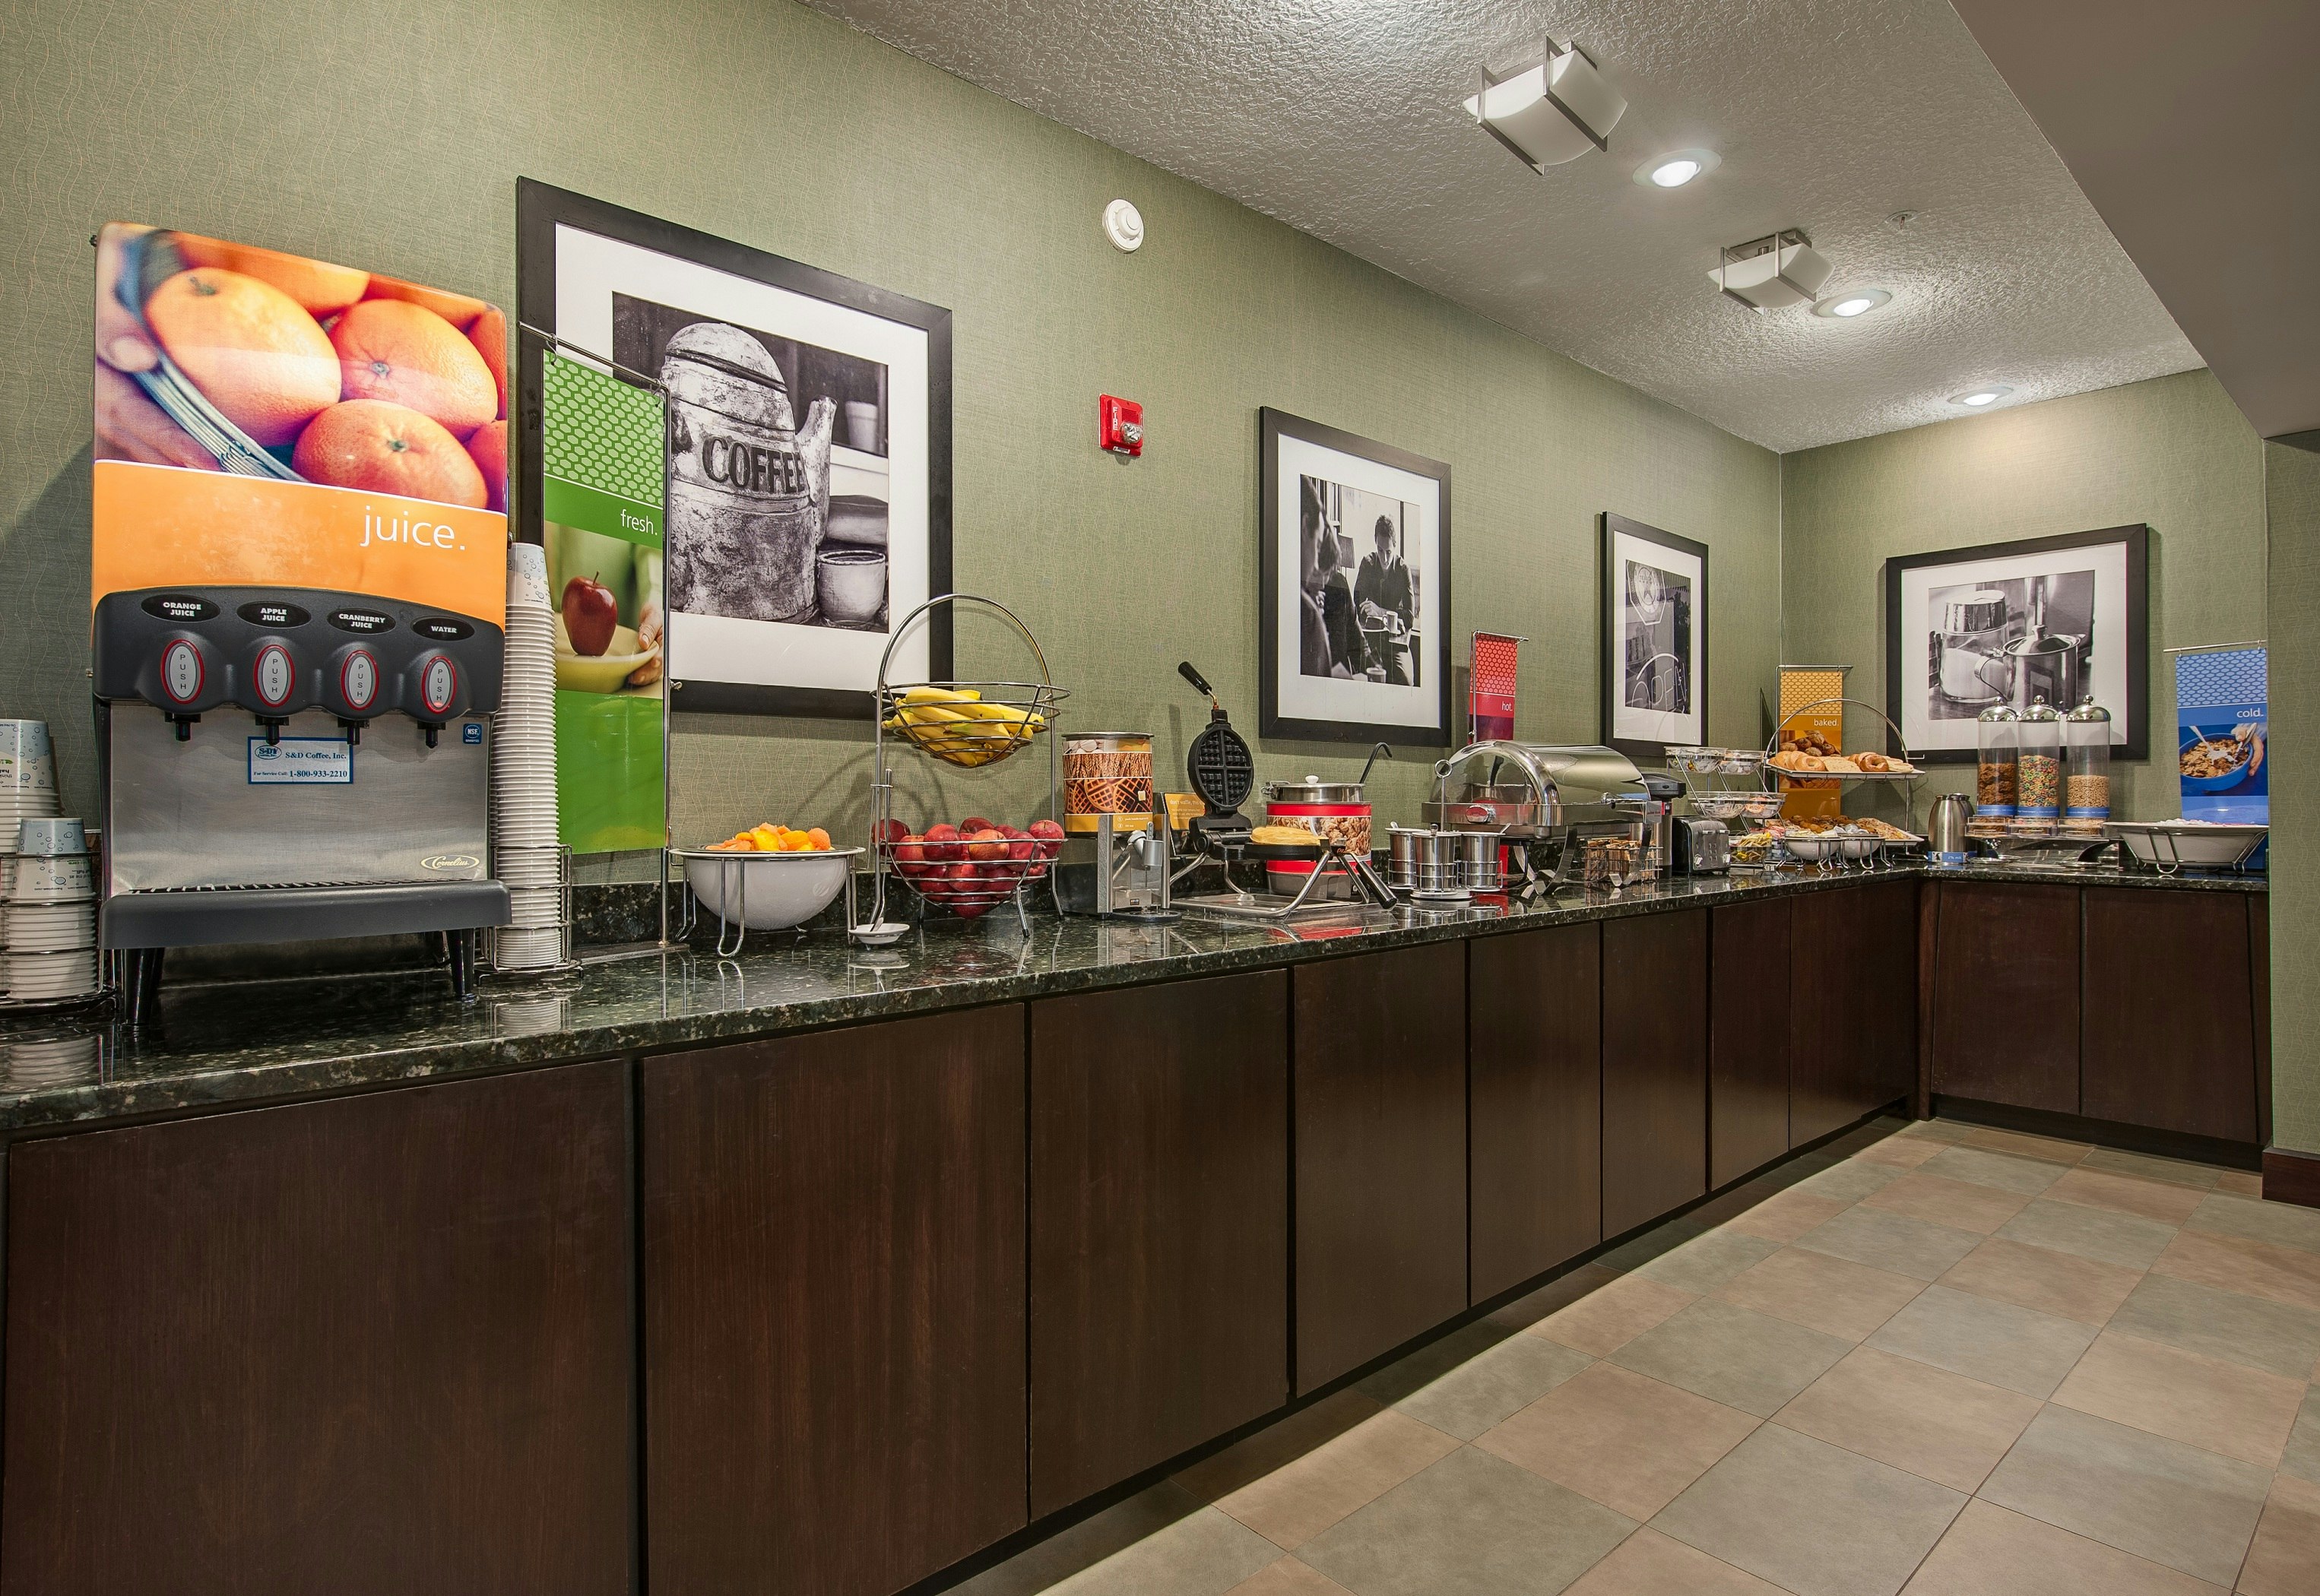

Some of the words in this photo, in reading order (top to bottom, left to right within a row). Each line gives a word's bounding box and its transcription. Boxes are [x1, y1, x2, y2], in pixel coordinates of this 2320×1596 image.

[702, 436, 806, 494] COFFEE
[620, 508, 658, 536] fresh.
[360, 505, 466, 551] juice.
[163, 602, 201, 610] ORANGE
[260, 607, 287, 616] APPLE
[338, 613, 386, 623] CRANBERRY
[431, 625, 458, 634] WATER
[2236, 708, 2265, 718] cold.
[1814, 718, 1840, 727] baked.
[433, 856, 470, 869] Cornelius
